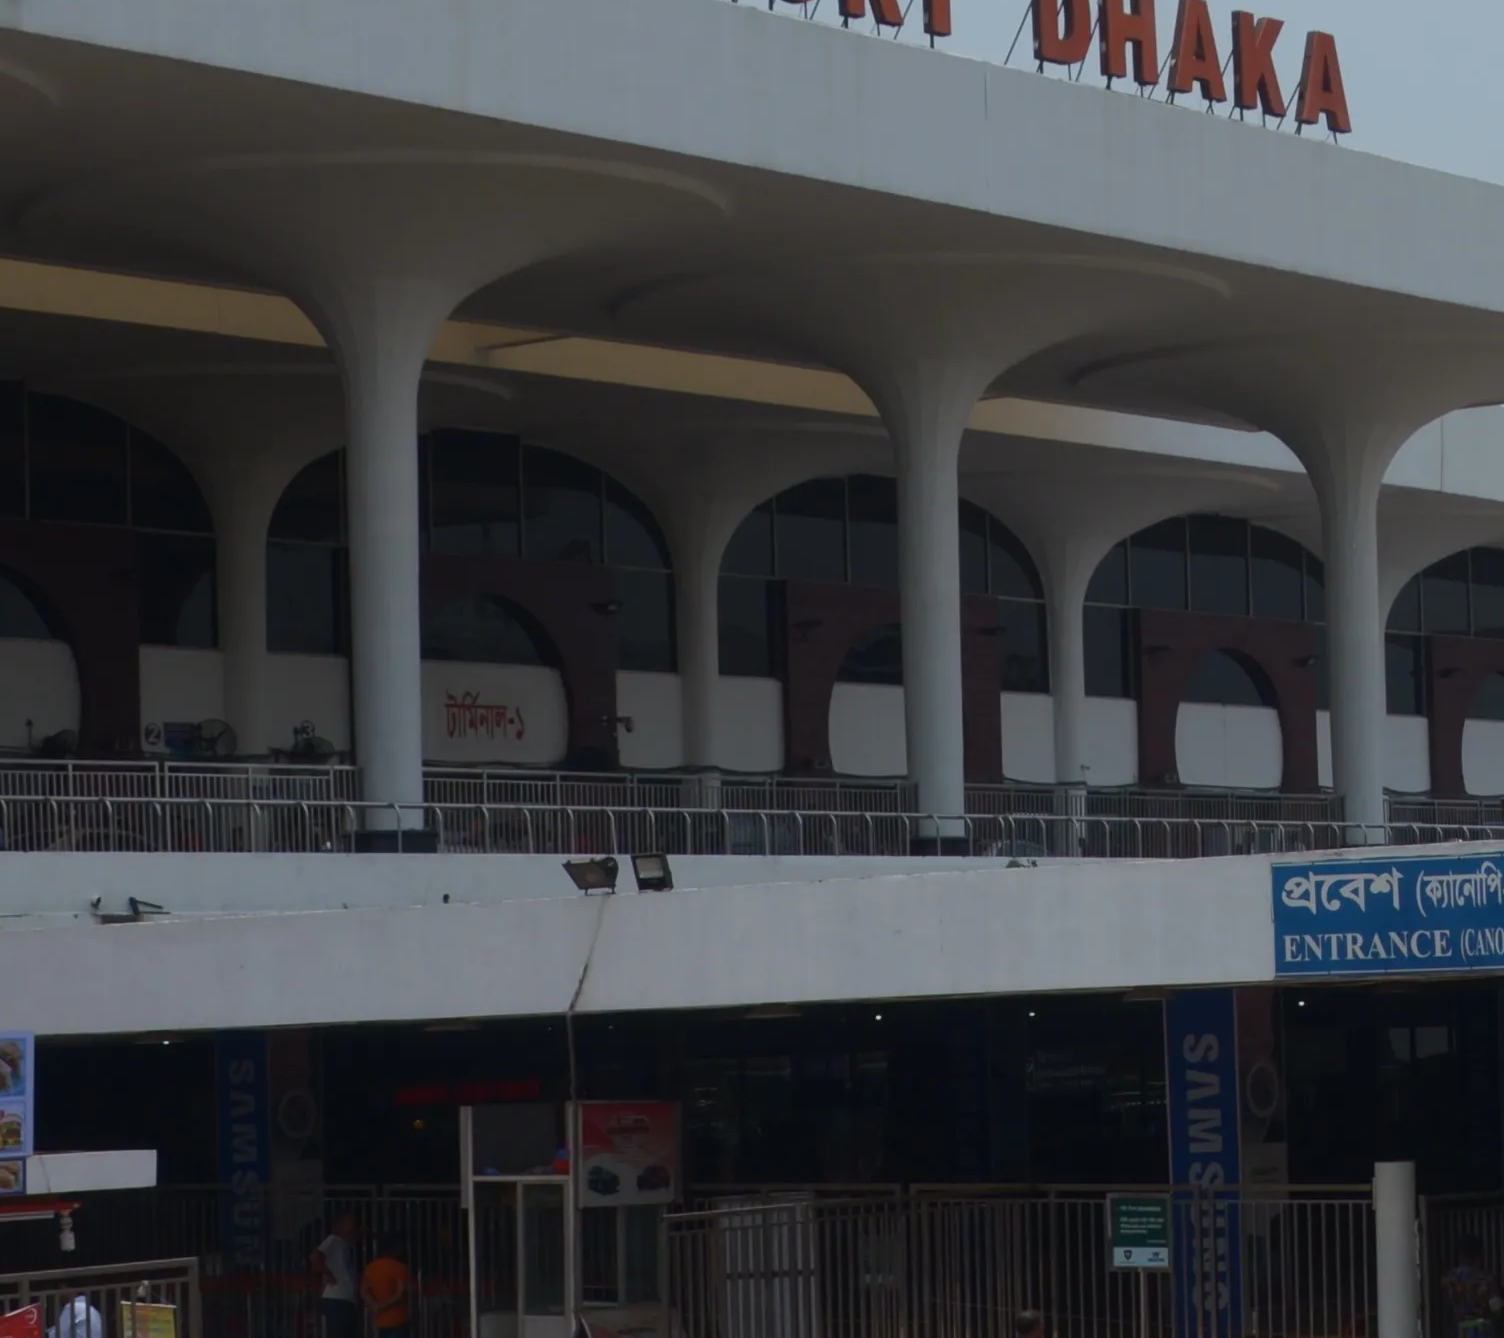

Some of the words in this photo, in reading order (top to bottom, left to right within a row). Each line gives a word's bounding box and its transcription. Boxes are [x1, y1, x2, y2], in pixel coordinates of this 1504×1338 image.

[444, 689, 525, 741] টার্মিনাল-১
[1281, 865, 1402, 914] প্রবেশ
[1283, 930, 1452, 963] ENTRANCE
